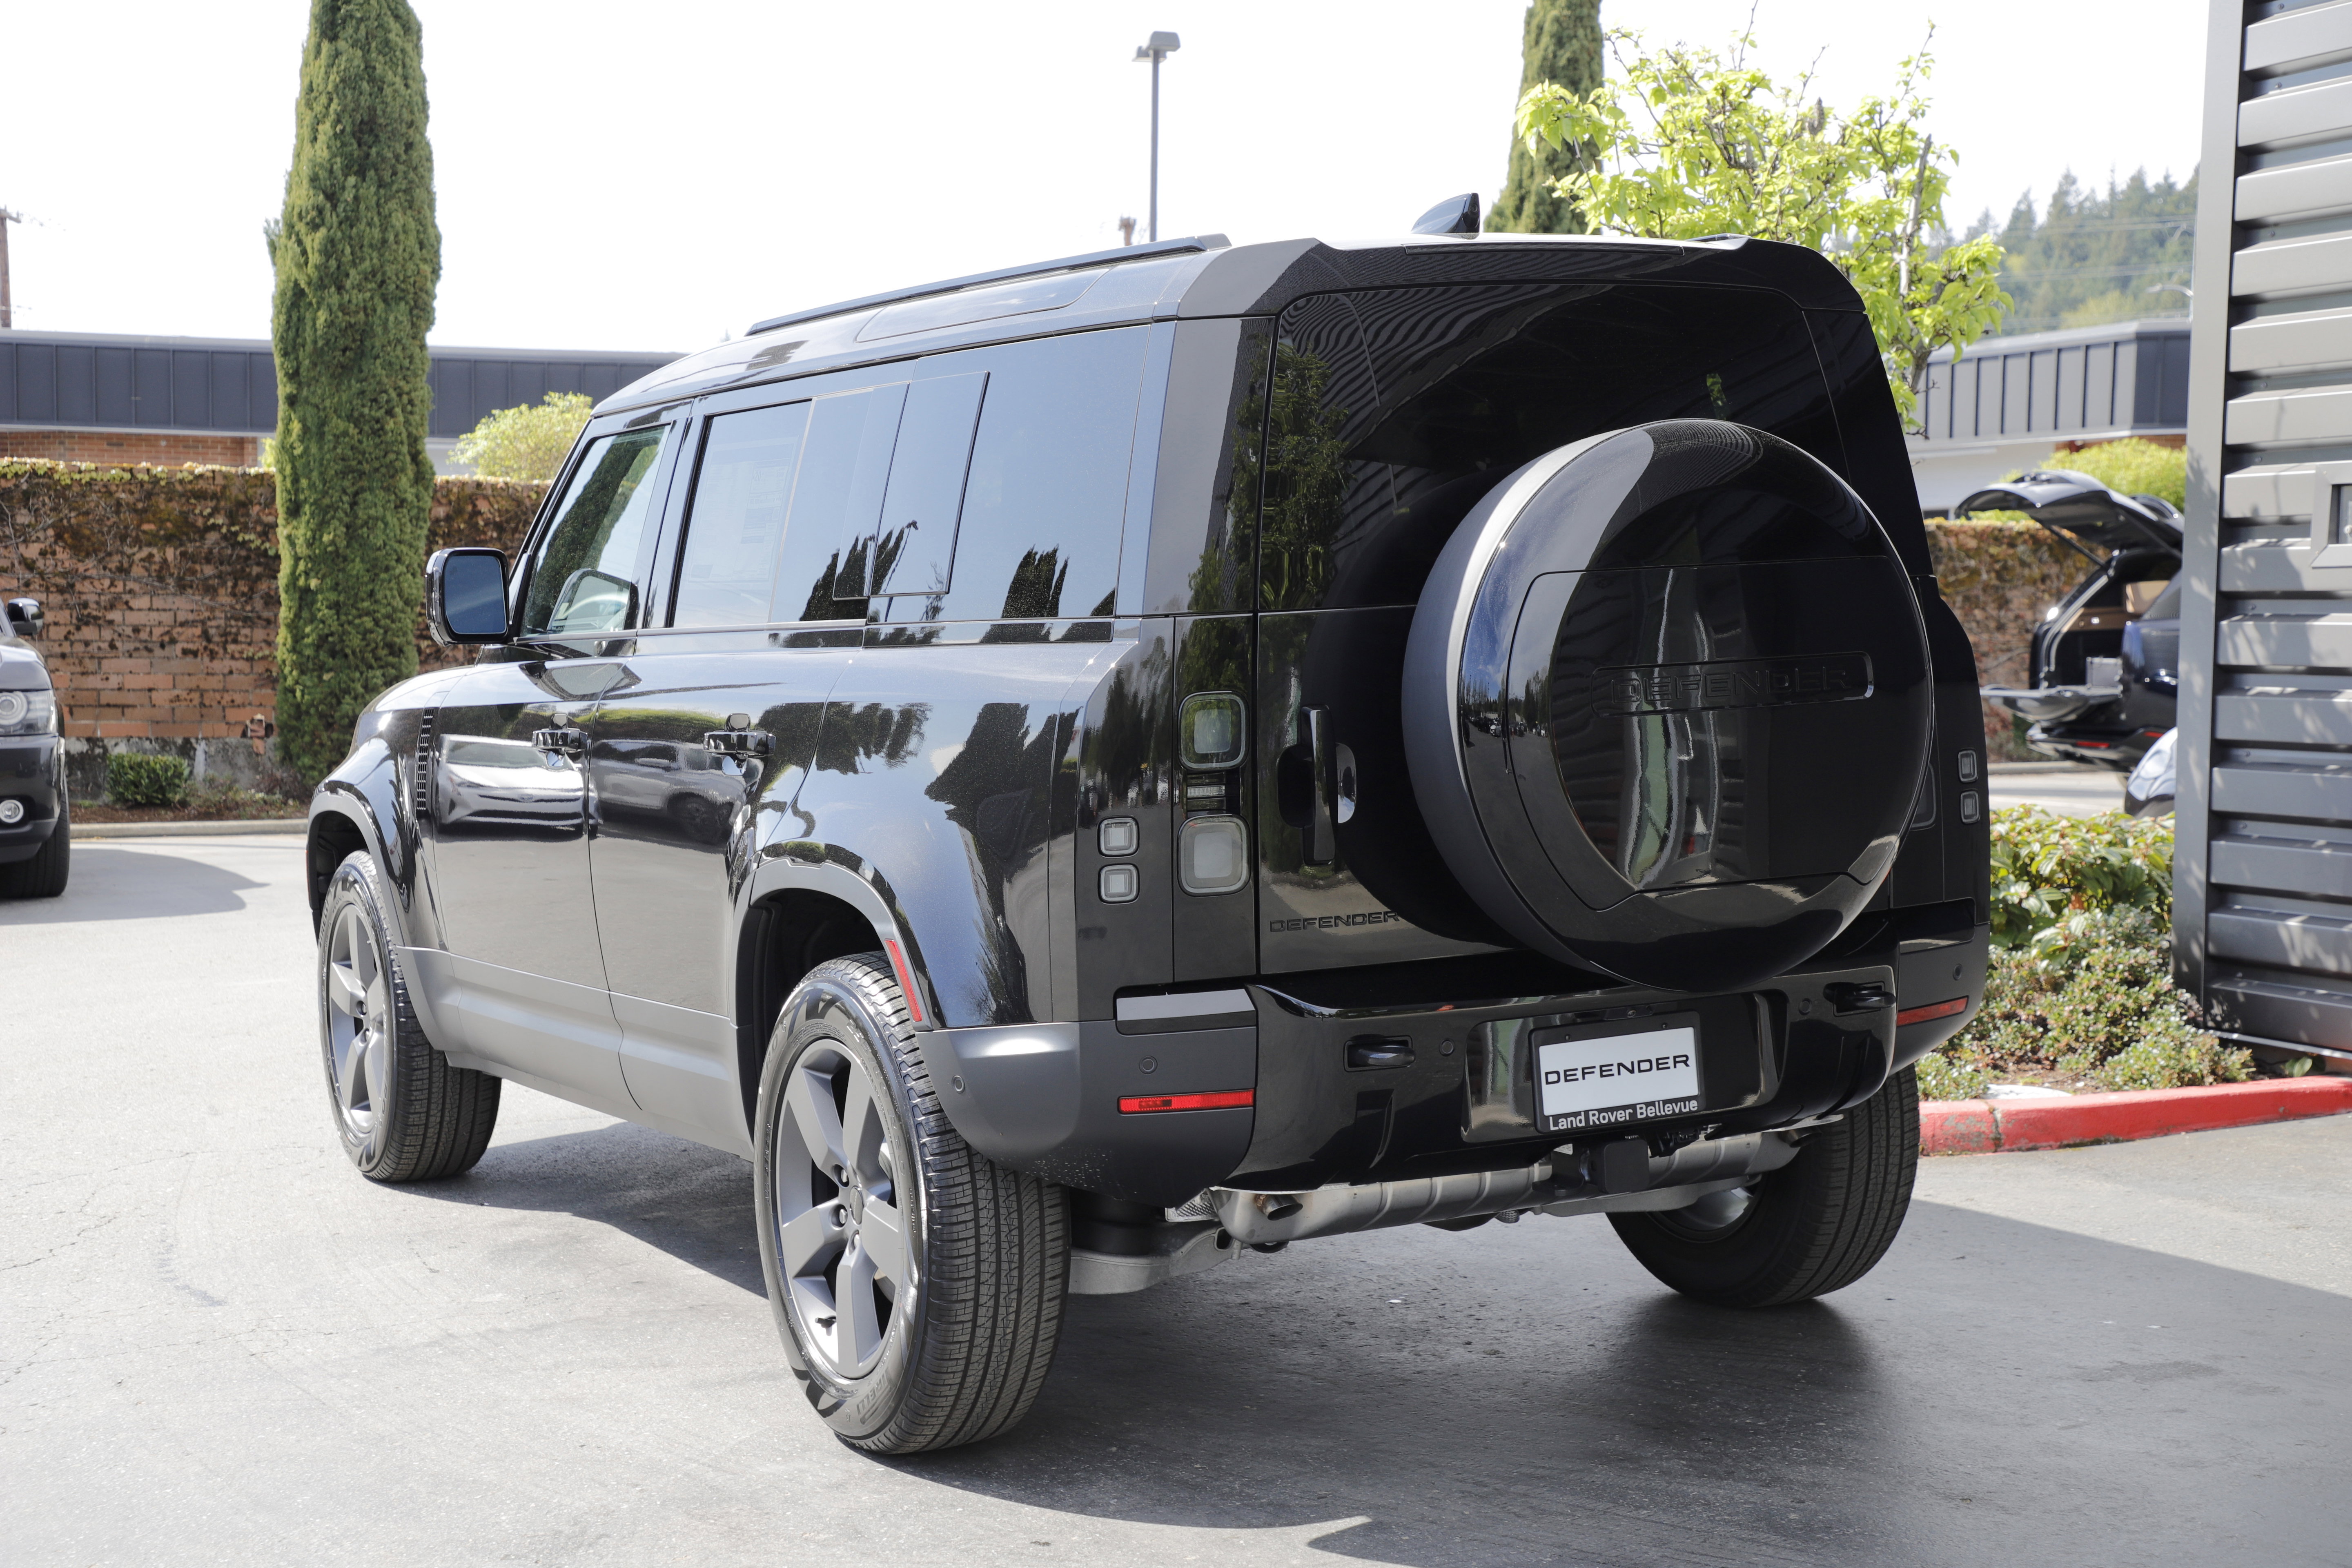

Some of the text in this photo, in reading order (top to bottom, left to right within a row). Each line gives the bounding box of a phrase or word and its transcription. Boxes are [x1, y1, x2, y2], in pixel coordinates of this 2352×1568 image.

[1611, 666, 1852, 704] DEFENDER
[1270, 911, 1401, 933] DEFENDER
[1544, 1054, 1690, 1085] DEFENDER
[1549, 1099, 1698, 1131] Land Rover Bellevue
[856, 1367, 896, 1425] PIRELLI
